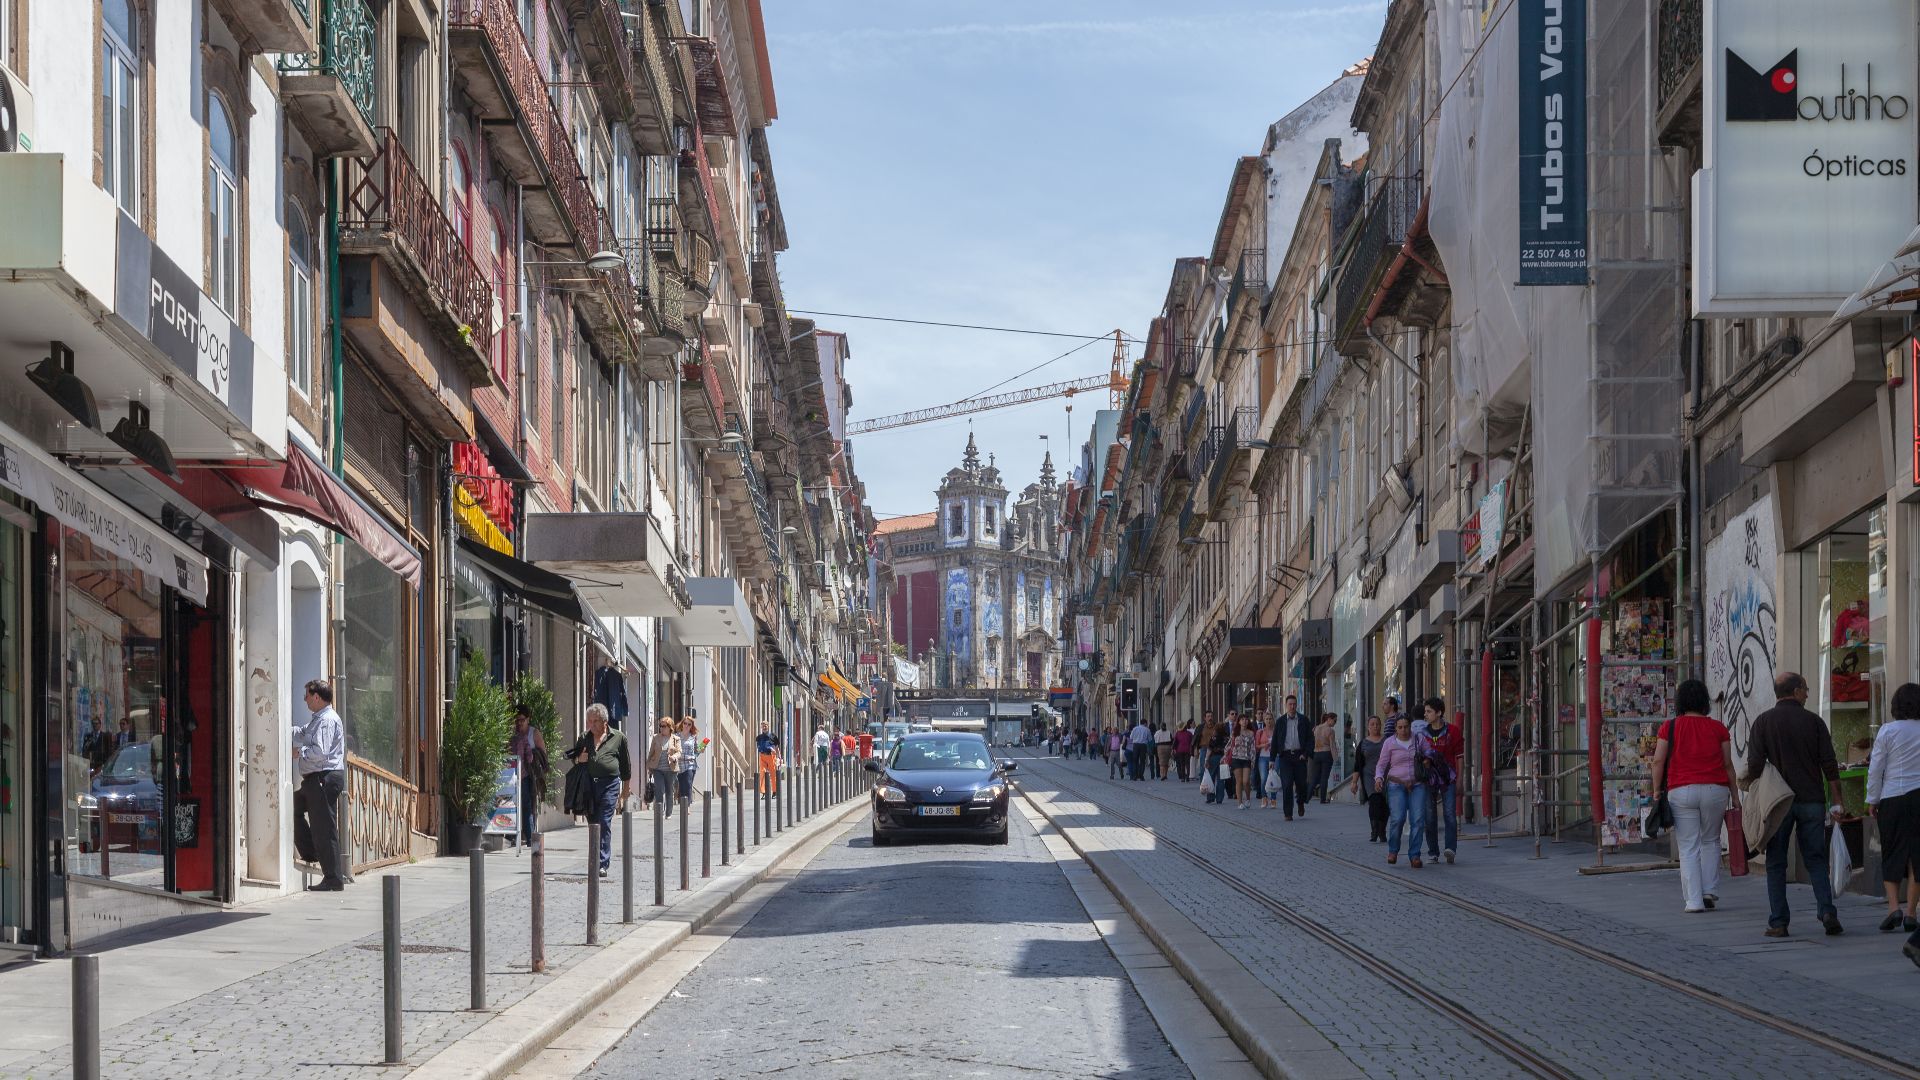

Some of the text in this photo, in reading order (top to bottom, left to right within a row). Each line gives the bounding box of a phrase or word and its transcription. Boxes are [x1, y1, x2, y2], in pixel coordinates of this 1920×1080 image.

[1726, 47, 1908, 122] Moutinho
[1541, 93, 1563, 230] Tubos
[1803, 149, 1906, 181] Ópticas
[1521, 260, 1586, 269] www.tubosvouga.pt
[1522, 248, 1586, 259] 22 507 48 10
[90, 510, 103, 537] EM
[858, 698, 864, 707] P
